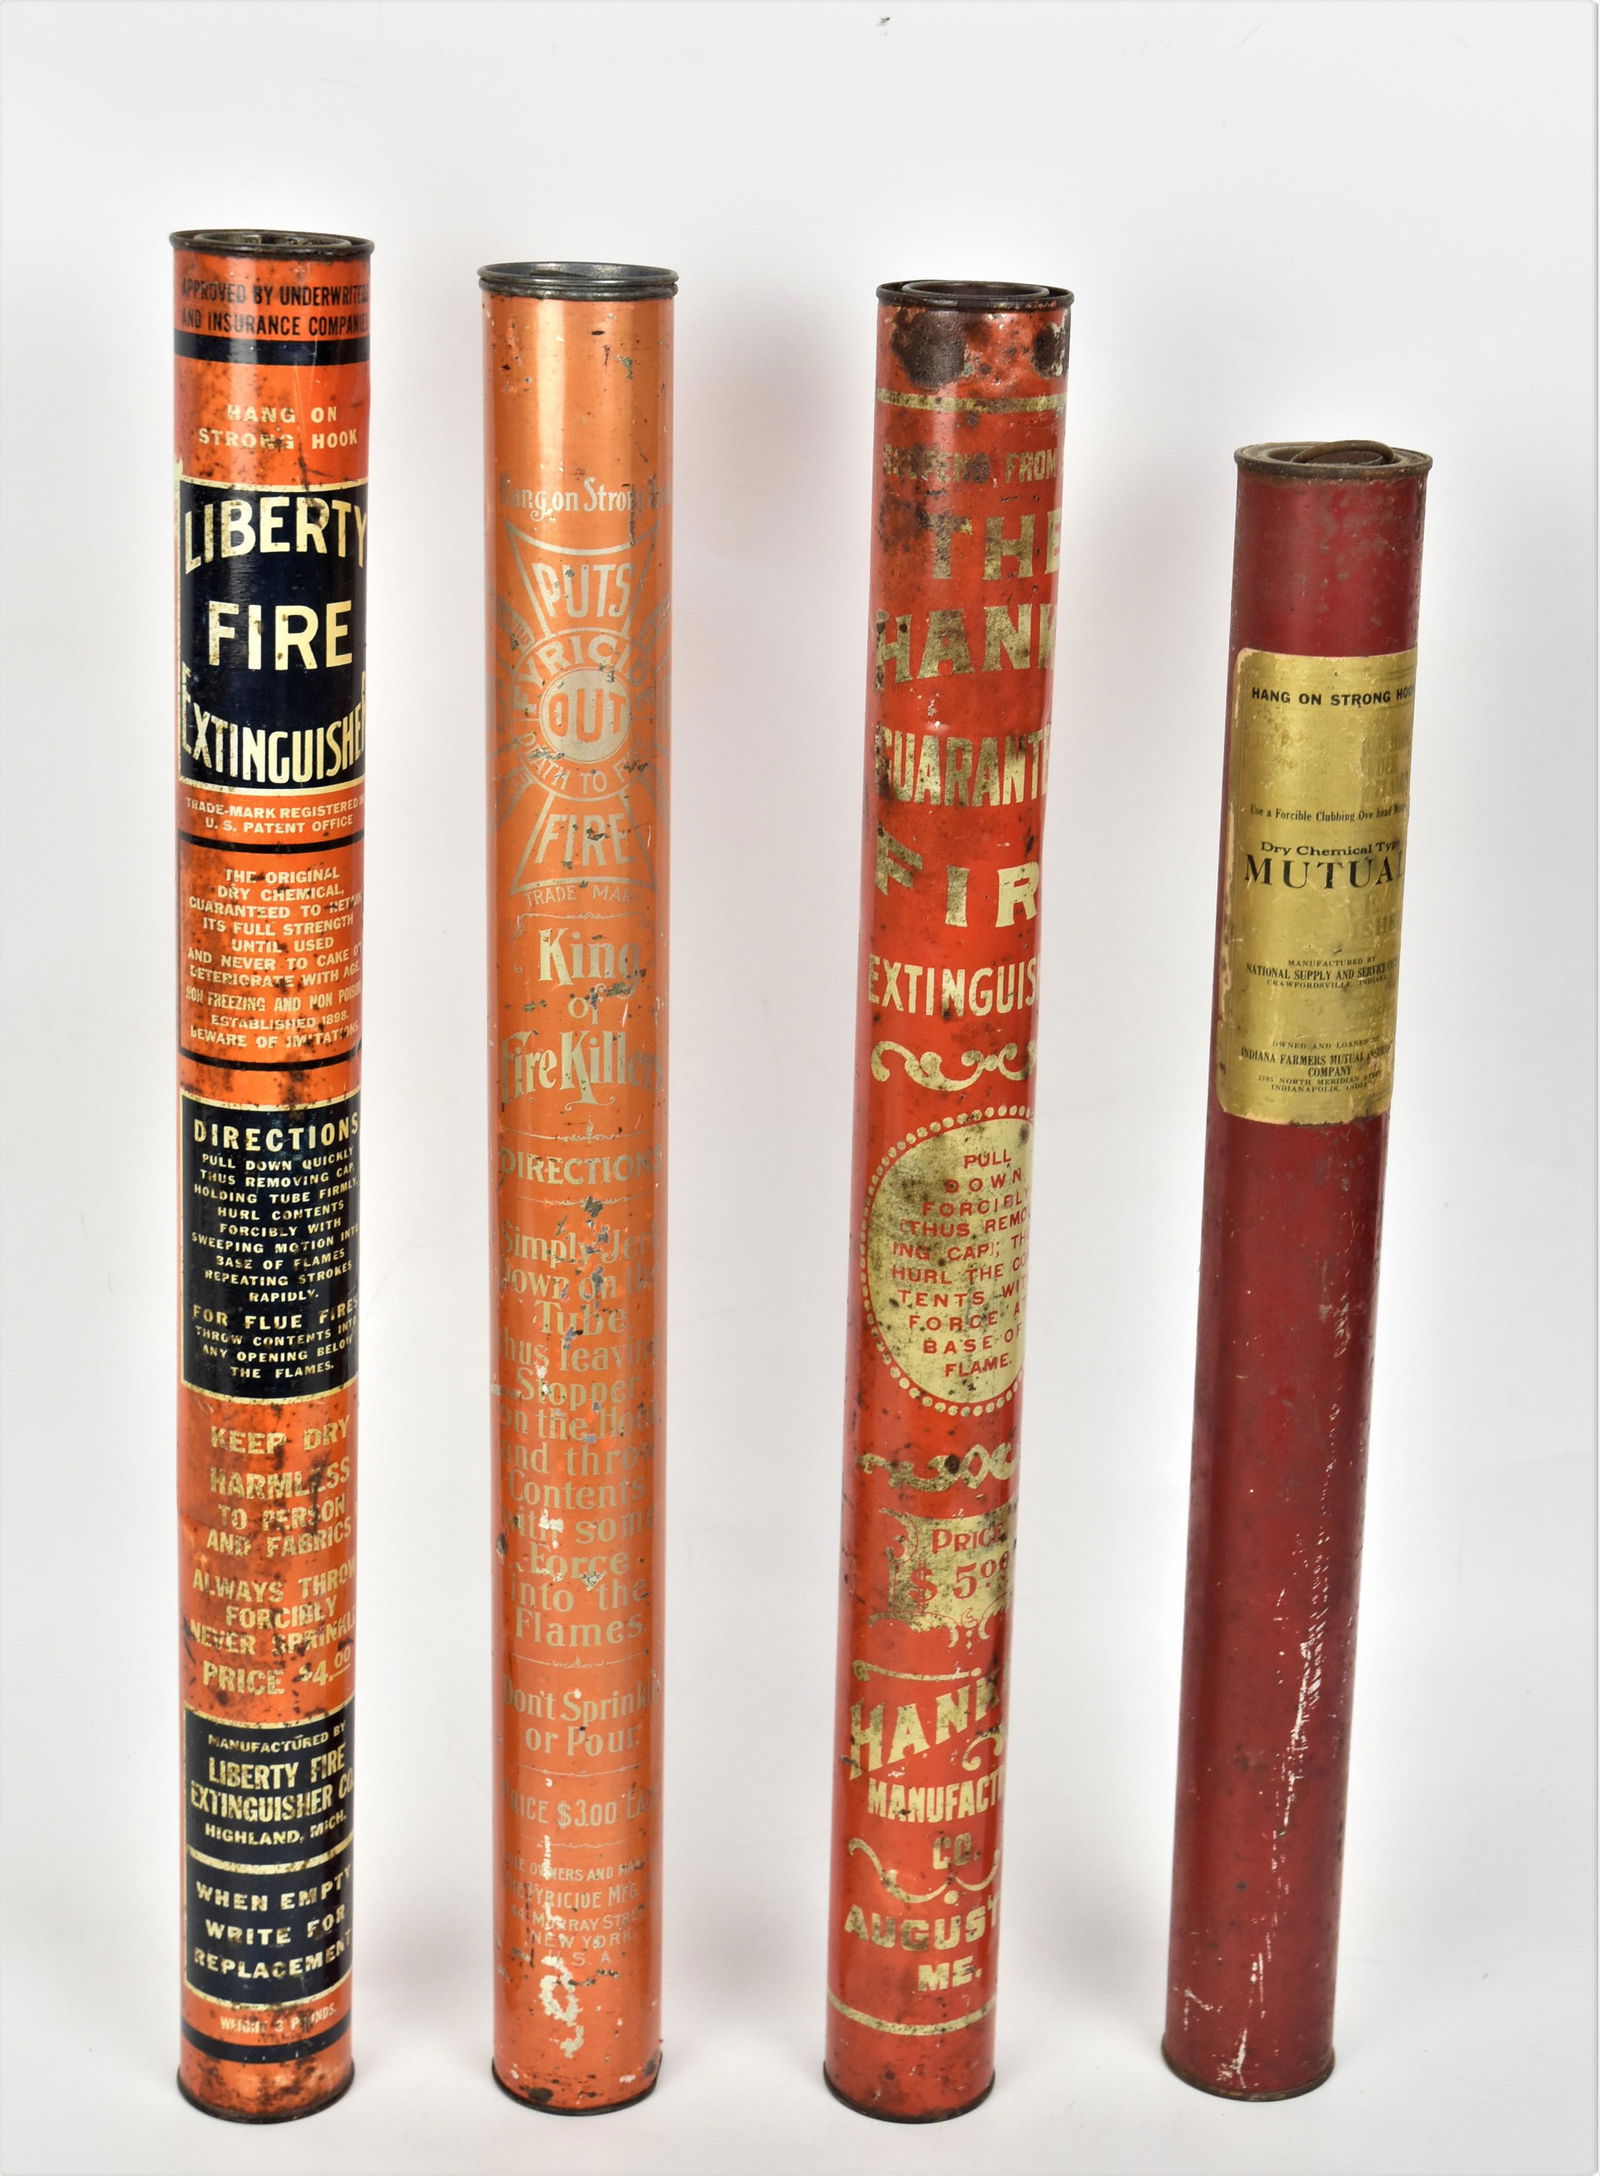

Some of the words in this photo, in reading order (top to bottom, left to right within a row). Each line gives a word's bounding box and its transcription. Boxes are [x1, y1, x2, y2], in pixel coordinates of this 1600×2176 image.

[253, 286, 272, 305] BY
[208, 314, 300, 336] INSURANCE
[227, 405, 295, 423] HANG
[312, 406, 337, 423] ON
[199, 428, 294, 449] STRONG
[312, 429, 357, 449] HOOK
[552, 492, 578, 512] on
[185, 497, 366, 574] LIBERTY
[532, 562, 634, 618] PUTS
[209, 600, 352, 670] FIRE
[1252, 687, 1290, 703] HANG
[1299, 694, 1321, 705] ON
[1331, 692, 1390, 705] STRONG
[549, 689, 627, 743] OUT
[581, 770, 607, 794] TO
[186, 798, 275, 818] TRADE-MARK
[280, 800, 358, 818] REGISTERED
[1251, 804, 1263, 816] Use
[1276, 809, 1312, 821] Forcible
[1316, 812, 1355, 822] Clubbing
[244, 822, 305, 833] PATENT
[312, 815, 353, 832] OFFICE
[535, 814, 637, 866] FIRE
[1262, 841, 1291, 856] Dry
[1297, 841, 1371, 856] Chemical
[226, 869, 256, 882] THE
[266, 867, 340, 883] ORIGINAL
[218, 884, 250, 900] DRY
[525, 886, 576, 906] TRADE
[190, 896, 290, 918] GUARANTEED
[301, 905, 321, 917] TO
[204, 917, 226, 932] ITS
[233, 923, 275, 936] FULL
[283, 915, 354, 936] STRENGTH
[232, 939, 283, 953] UNTIL
[294, 937, 334, 952] USED
[188, 948, 212, 963] AND
[221, 956, 275, 970] NEVER
[287, 958, 308, 969] TO
[317, 949, 349, 966] CAKE
[538, 928, 641, 999] King
[1288, 956, 1363, 967] MANUFACTURED
[303, 969, 338, 986] WITH
[1246, 963, 1290, 979] NATIONAL
[1294, 968, 1331, 981] SUPPLY
[1336, 968, 1354, 980] AND
[208, 991, 265, 1011] FREEZING
[275, 997, 301, 1012] AND
[568, 983, 606, 1024] of
[212, 1014, 316, 1029] ESTABLISHED
[256, 1036, 278, 1048] OF
[1272, 1041, 1306, 1049] OWNED
[1337, 1039, 1369, 1049] LOANED
[1241, 1047, 1275, 1063] INDIANA
[1280, 1055, 1326, 1066] FARMERS
[1330, 1051, 1364, 1065] MUTUAL
[1308, 1065, 1351, 1077] COMPANY
[1318, 1076, 1359, 1085] MERIDIAN
[194, 1112, 358, 1152] DIRECTIONS
[203, 1153, 235, 1169] PULL
[246, 1160, 292, 1171] DOWN
[302, 1146, 354, 1169] QUICKLY
[964, 1150, 1012, 1169] PULL
[200, 1169, 235, 1185] THUS
[246, 1172, 329, 1187] REMOVING
[945, 1169, 1022, 1194] DOWN
[195, 1184, 257, 1203] HOLDING
[270, 1192, 310, 1204] TUBE
[218, 1207, 260, 1220] HURL
[272, 1200, 344, 1220] CONTENTS
[220, 1224, 297, 1237] FORCIBLY
[308, 1217, 341, 1233] WITH
[192, 1232, 264, 1253] SWEEPING
[275, 1236, 334, 1253] MOTION
[894, 1241, 930, 1260] ING
[216, 1256, 253, 1269] BASE
[263, 1260, 283, 1270] OF
[294, 1248, 345, 1269] FLAMES
[205, 1269, 288, 1286] REPEATING
[299, 1260, 352, 1285] STROKES
[892, 1264, 952, 1284] HURL
[966, 1263, 1003, 1282] THE
[249, 1289, 318, 1302] RAPIDLY.
[899, 1289, 984, 1307] TENTS
[193, 1304, 228, 1326] FOR
[245, 1315, 302, 1330] FLUE
[535, 1300, 627, 1335] Tube
[910, 1312, 998, 1331] FORCE
[196, 1325, 242, 1345] THROW
[253, 1330, 331, 1346] CONTENTS
[924, 1336, 992, 1354] BASE
[1005, 1323, 1022, 1343] OF
[203, 1344, 227, 1358] ANY
[237, 1350, 308, 1362] OPENING
[231, 1366, 260, 1378] THE
[275, 1362, 334, 1378] FLAMES.
[945, 1353, 1012, 1377] FLAME.
[211, 1426, 287, 1454] KEEP
[304, 1415, 350, 1451] DRY
[537, 1409, 587, 1440] the
[509, 1473, 647, 1510] Contents
[219, 1504, 247, 1530] TO
[263, 1494, 345, 1531] PERSON
[207, 1529, 251, 1556] AND
[267, 1516, 351, 1558] FABRICS
[932, 1523, 1004, 1554] PRICE
[530, 1541, 629, 1579] Force
[193, 1568, 284, 1602] ALWAYS
[512, 1573, 574, 1612] into
[599, 1579, 649, 1611] the
[226, 1596, 337, 1629] FORCIBLY
[190, 1620, 255, 1655] NEVER
[516, 1607, 646, 1647] Flames
[203, 1660, 284, 1695] PRICE
[209, 1731, 328, 1753] MANUFACTURED
[333, 1721, 345, 1737] BY
[526, 1728, 558, 1753] or
[209, 1757, 299, 1790] LIBERTY
[311, 1742, 345, 1783] FIRE
[191, 1780, 332, 1822] EXTINGUISHER
[205, 1823, 303, 1845] HIGHLAND,
[311, 1809, 346, 1838] MICH.
[933, 1832, 980, 1869] CO.
[587, 1867, 613, 1880] AND
[196, 1881, 268, 1911] WHEN
[281, 1866, 350, 1910] EMPTY
[206, 1919, 291, 1945] WRITE
[307, 1904, 345, 1938] FOR
[530, 1931, 575, 1948] NEW
[194, 1929, 351, 1979] REPLACEMENT
[918, 1955, 982, 1991] ME.
